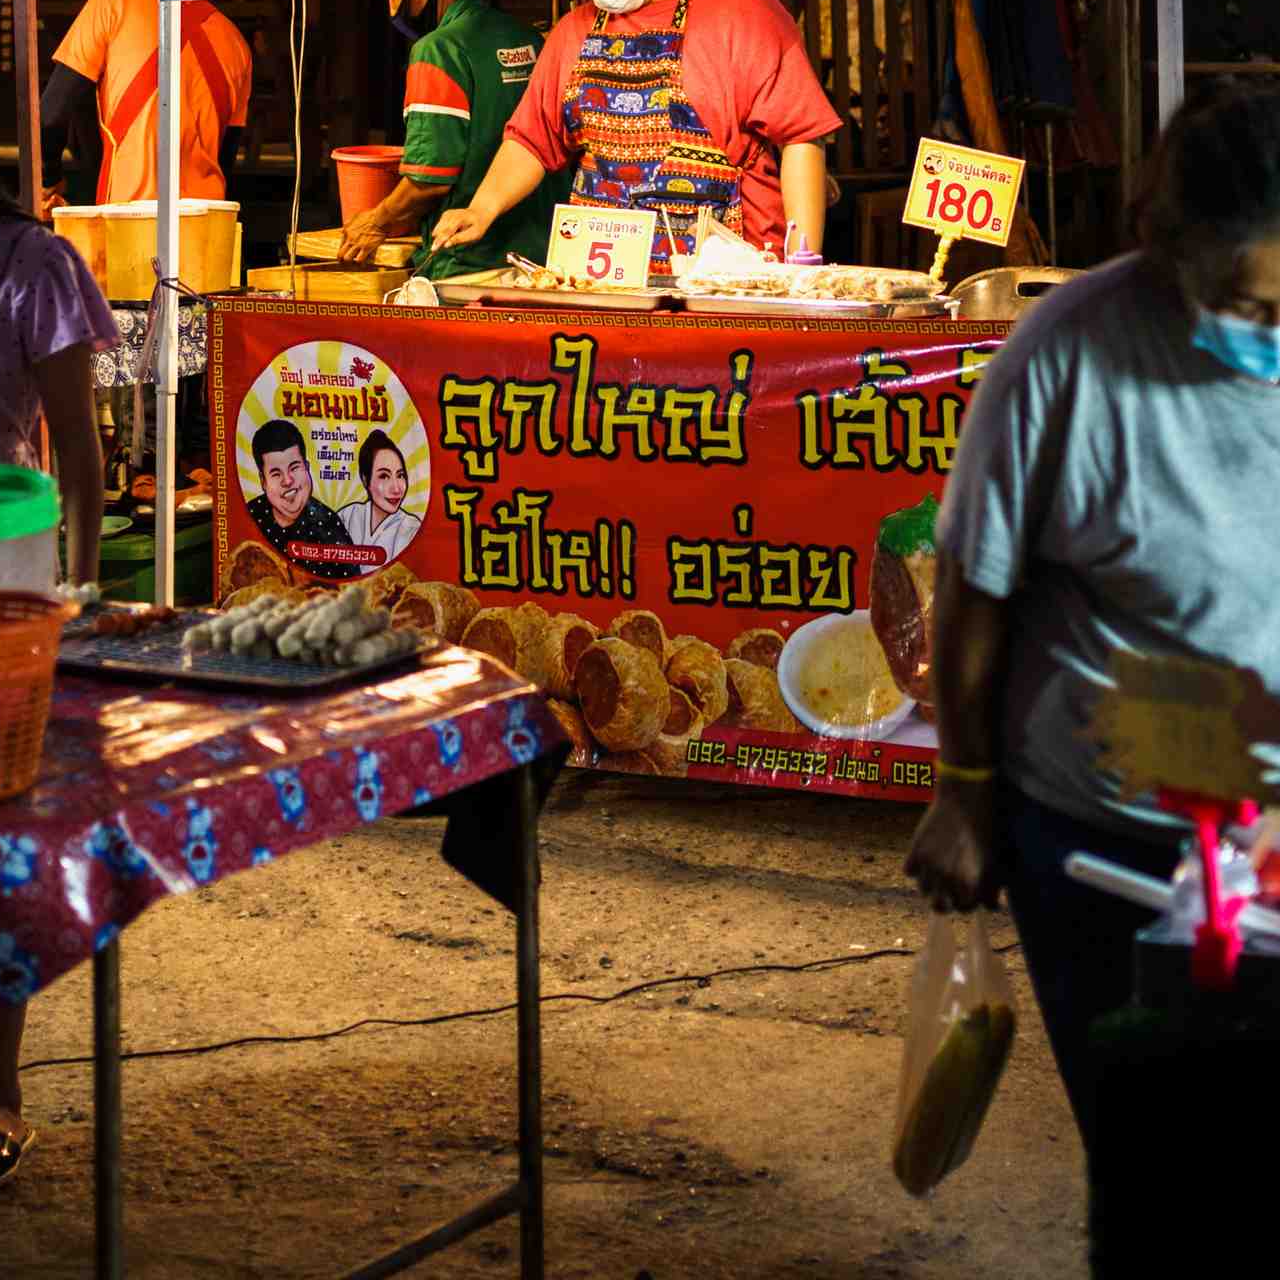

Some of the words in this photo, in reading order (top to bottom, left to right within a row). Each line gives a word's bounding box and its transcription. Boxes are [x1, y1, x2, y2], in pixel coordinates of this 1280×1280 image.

[926, 178, 993, 229] 180
[587, 241, 613, 279] 5
[308, 368, 355, 388] แม่กลอง
[282, 384, 389, 422] มอนเปย์
[441, 334, 753, 478] ลูกใหญ่
[310, 426, 359, 442] อร่อยใหญ่
[666, 506, 856, 612] อร่อย
[687, 739, 827, 775] 092-9795332
